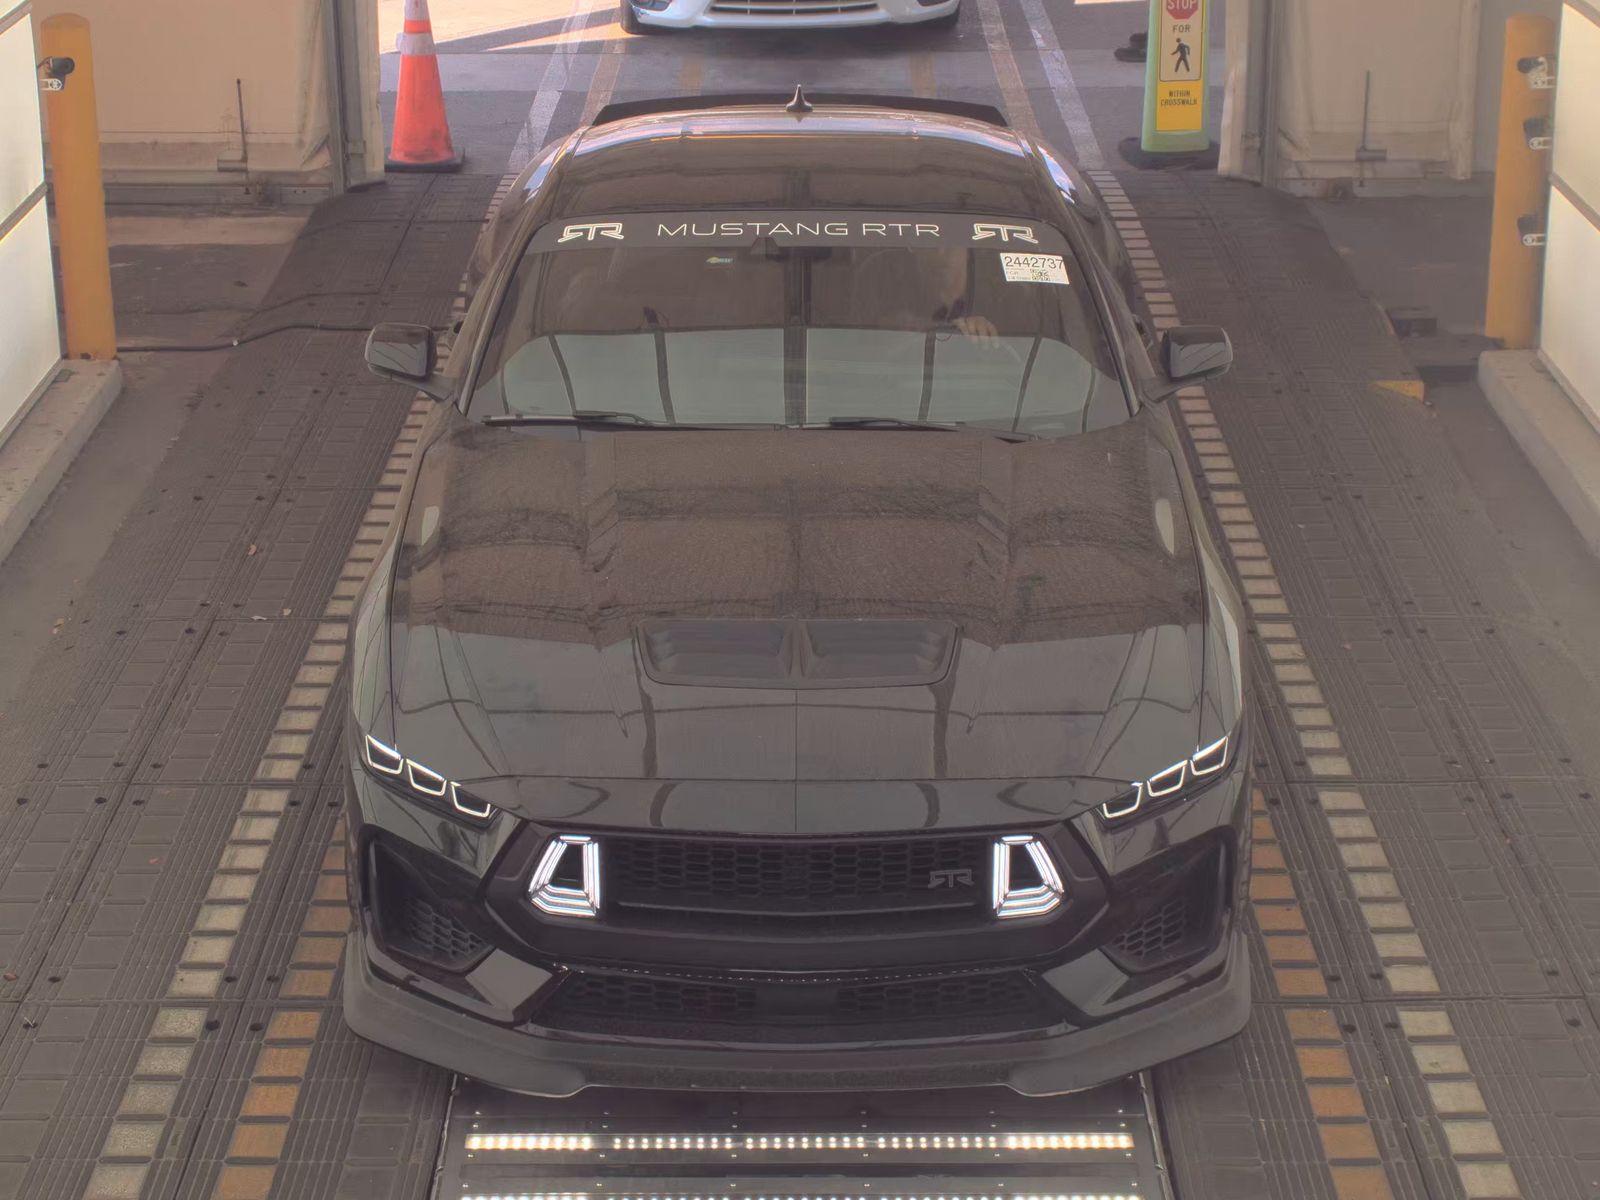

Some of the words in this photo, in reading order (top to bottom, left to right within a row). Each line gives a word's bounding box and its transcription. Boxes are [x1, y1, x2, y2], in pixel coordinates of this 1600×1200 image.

[1167, 0, 1197, 9] STOP
[1172, 24, 1191, 32] FOR
[1160, 98, 1198, 107] CROSSWALK
[657, 222, 848, 237] MUSTANG
[862, 223, 941, 237] RTR
[1004, 255, 1063, 270] 2442737
